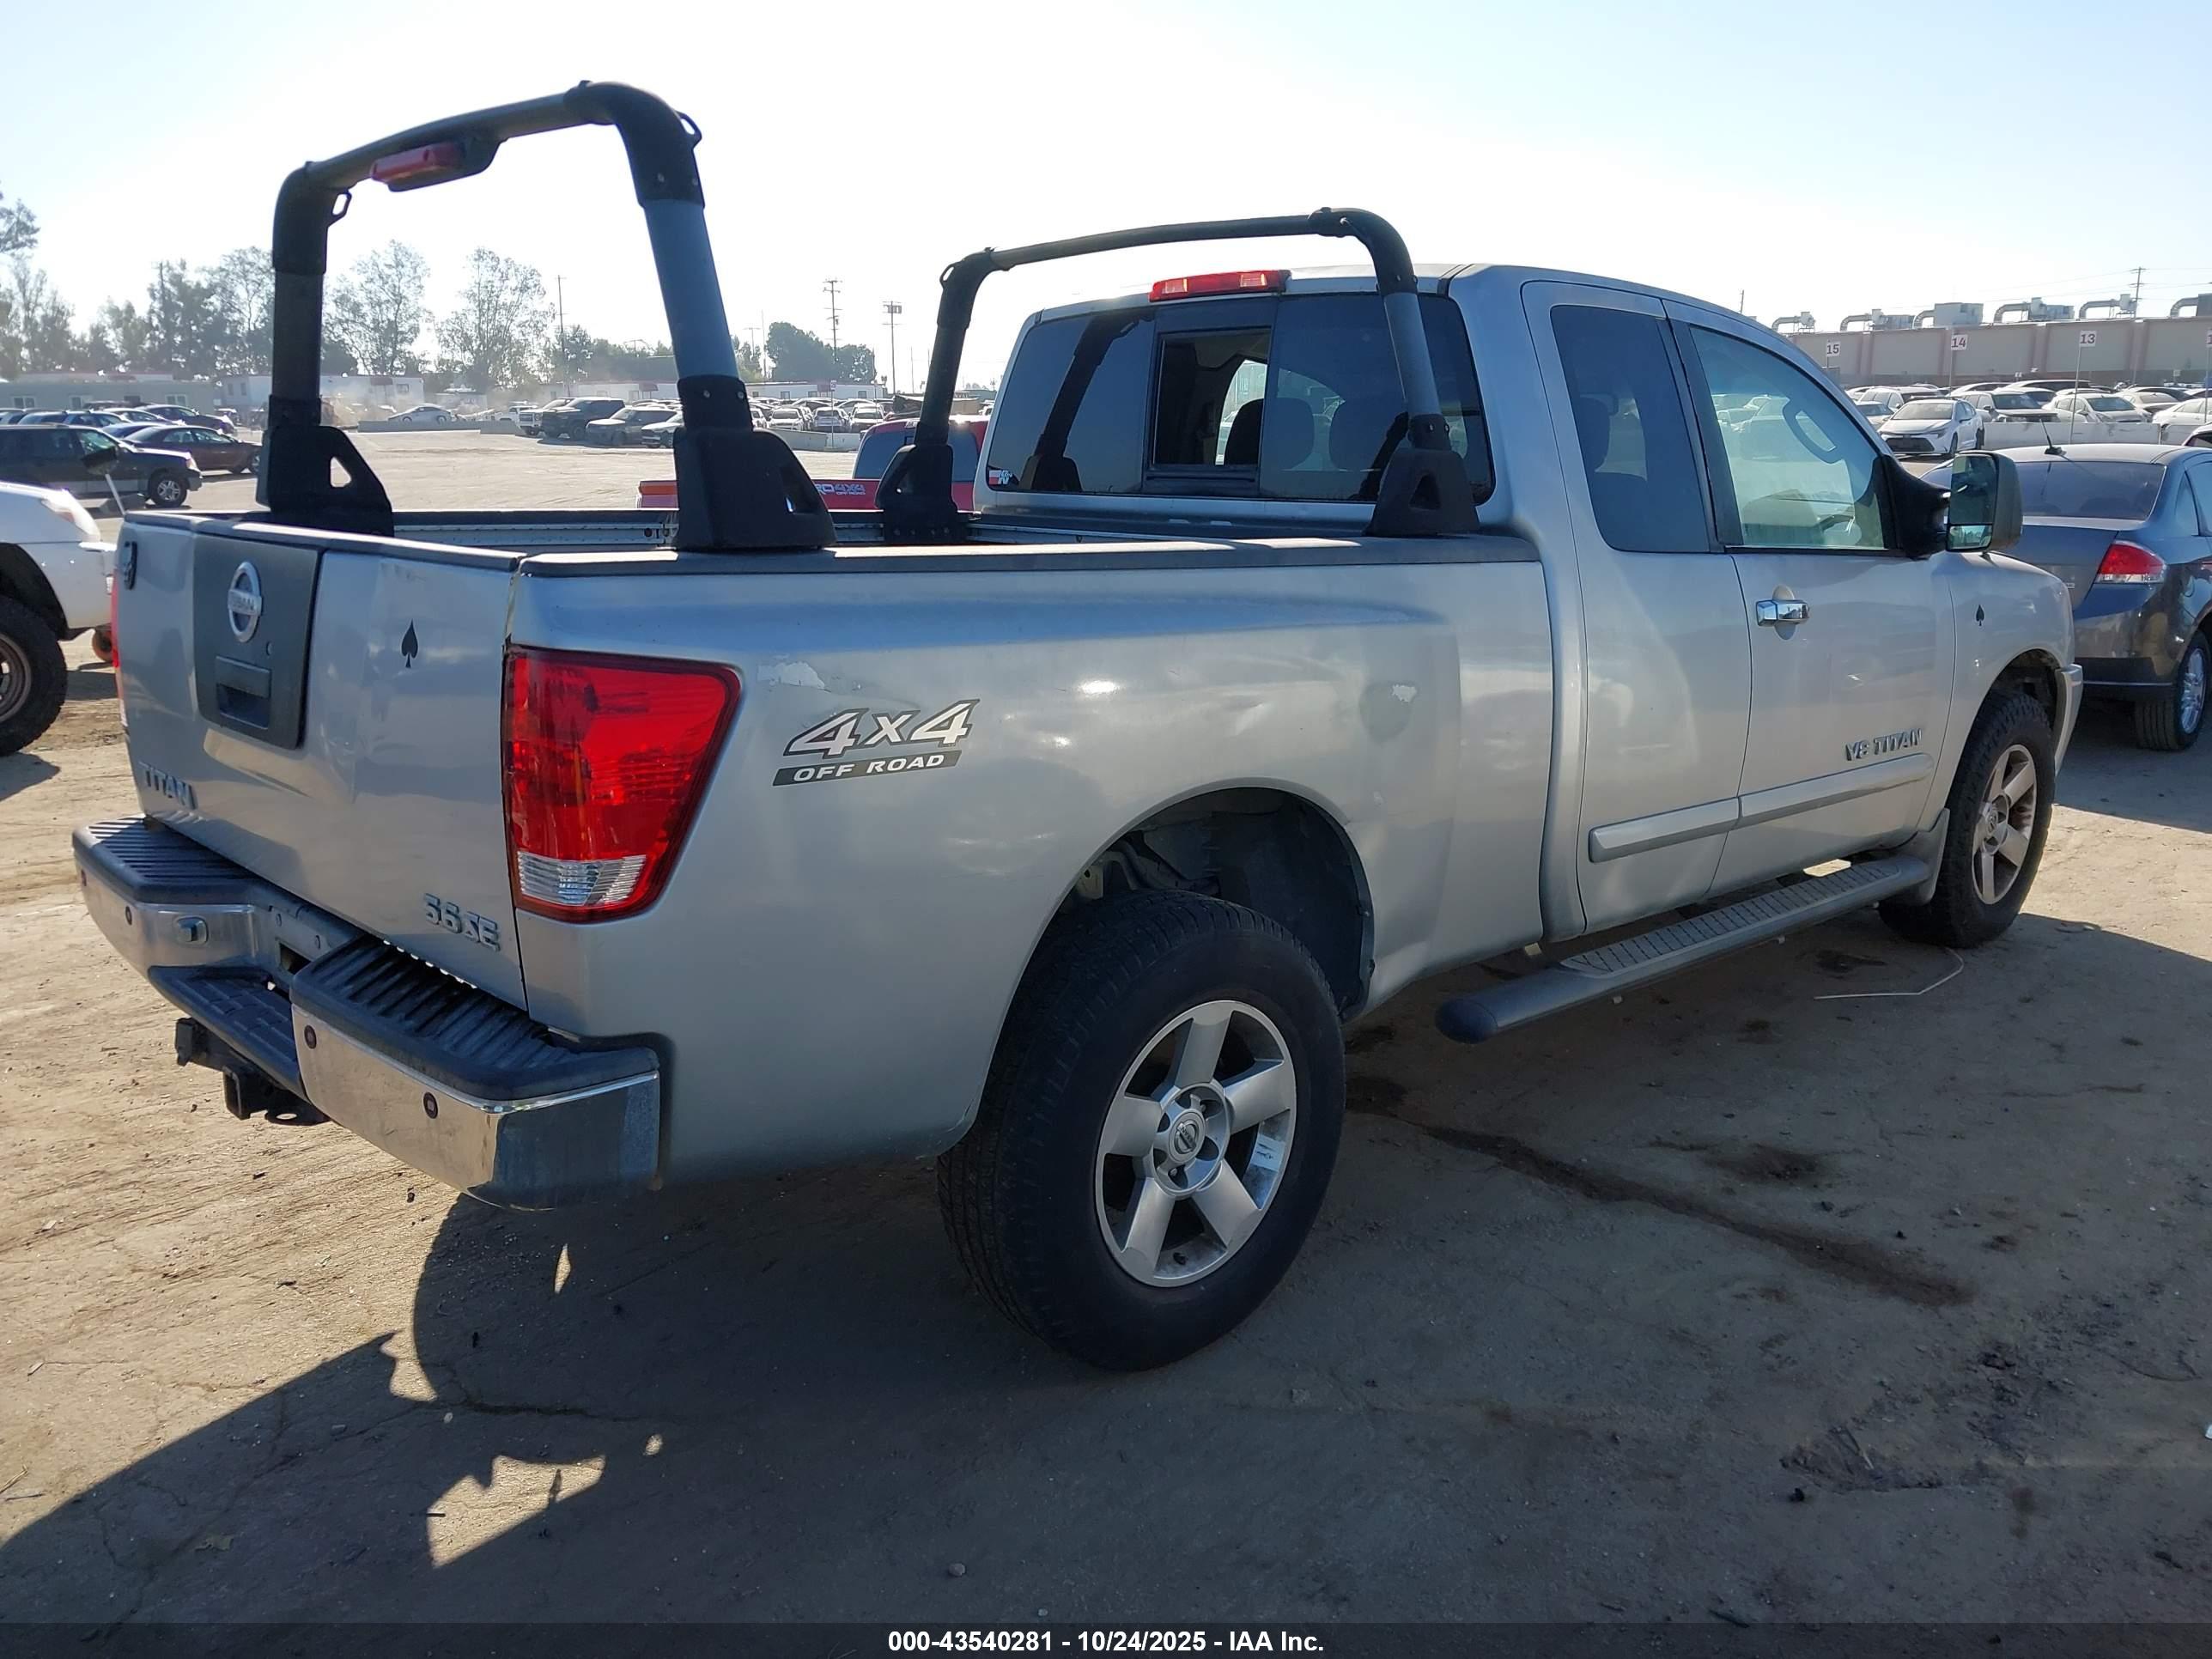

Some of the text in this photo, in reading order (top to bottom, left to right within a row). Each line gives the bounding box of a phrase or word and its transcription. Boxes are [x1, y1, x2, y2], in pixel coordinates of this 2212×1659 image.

[1951, 337, 1966, 349] 14
[2080, 333, 2096, 344] 13
[1826, 343, 1839, 355] 15
[1844, 728, 1923, 762] V8 TITAN
[793, 754, 945, 782] OFF ROAD
[138, 761, 198, 811] TITAN
